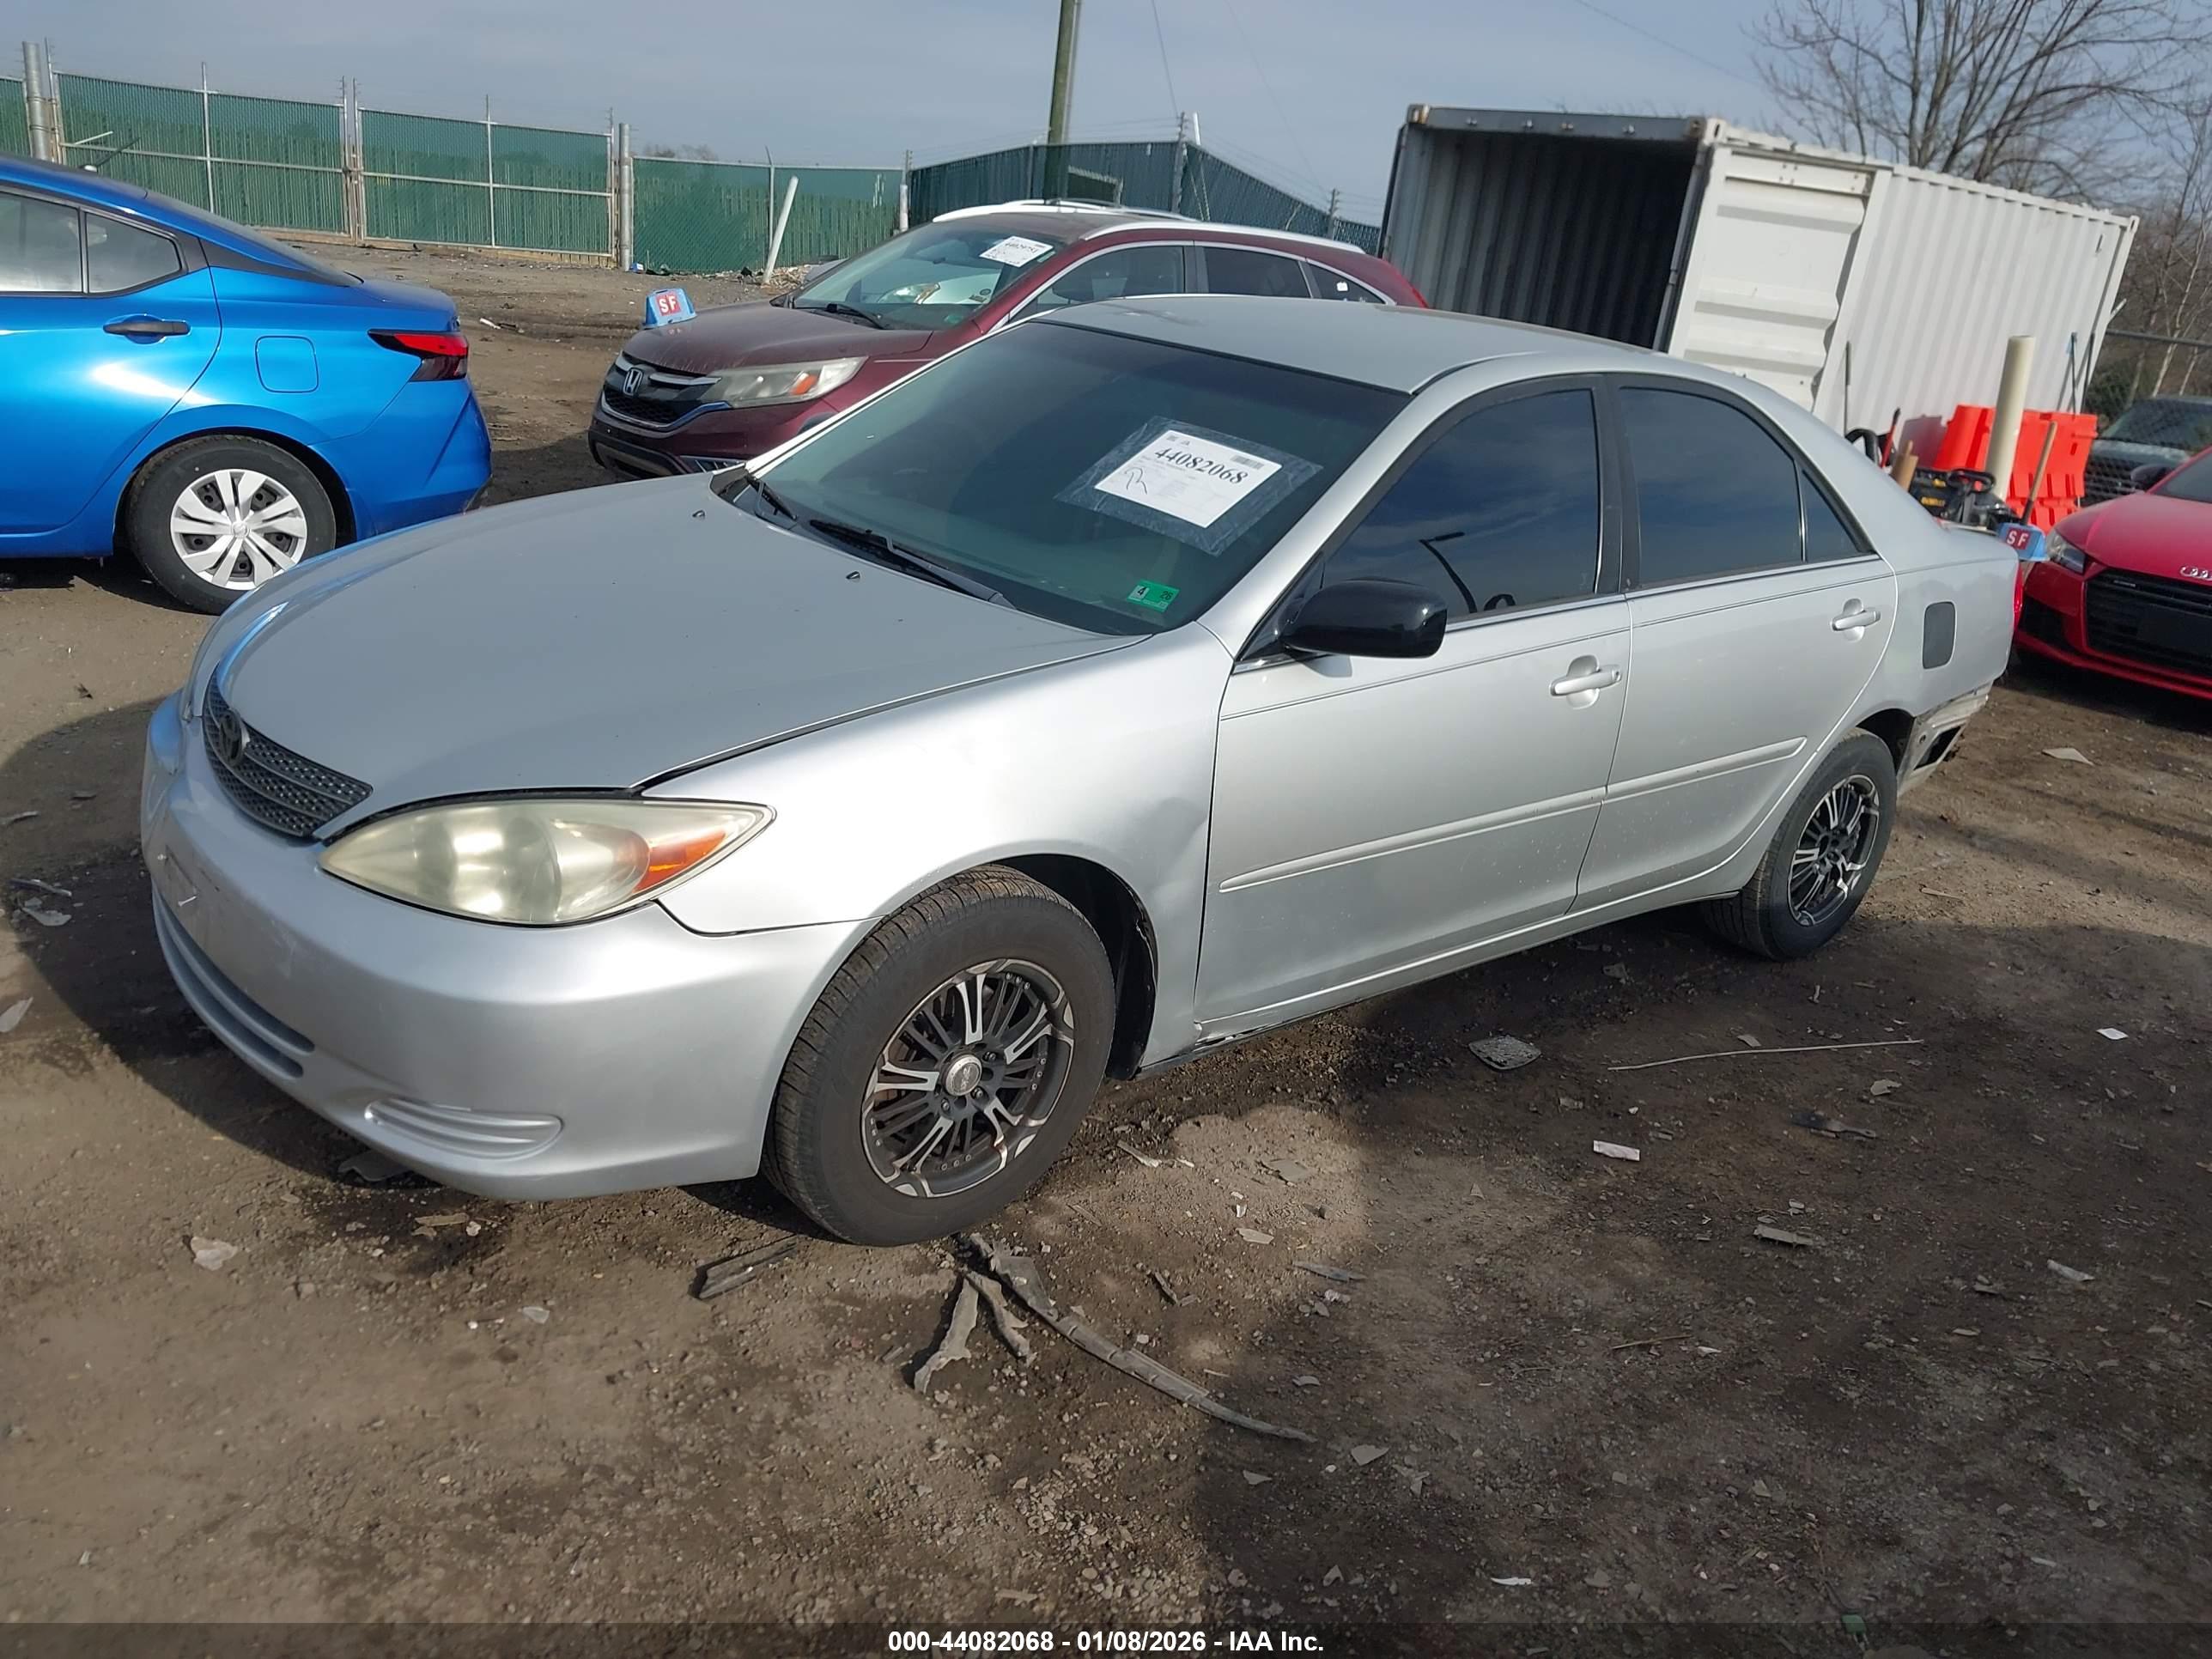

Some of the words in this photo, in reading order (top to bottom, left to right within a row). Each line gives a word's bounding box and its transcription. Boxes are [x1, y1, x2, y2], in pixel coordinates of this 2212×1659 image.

[659, 295, 677, 313] SF
[1154, 447, 1249, 485] 44082068
[1137, 586, 1148, 596] 4
[1159, 590, 1174, 601] 26
